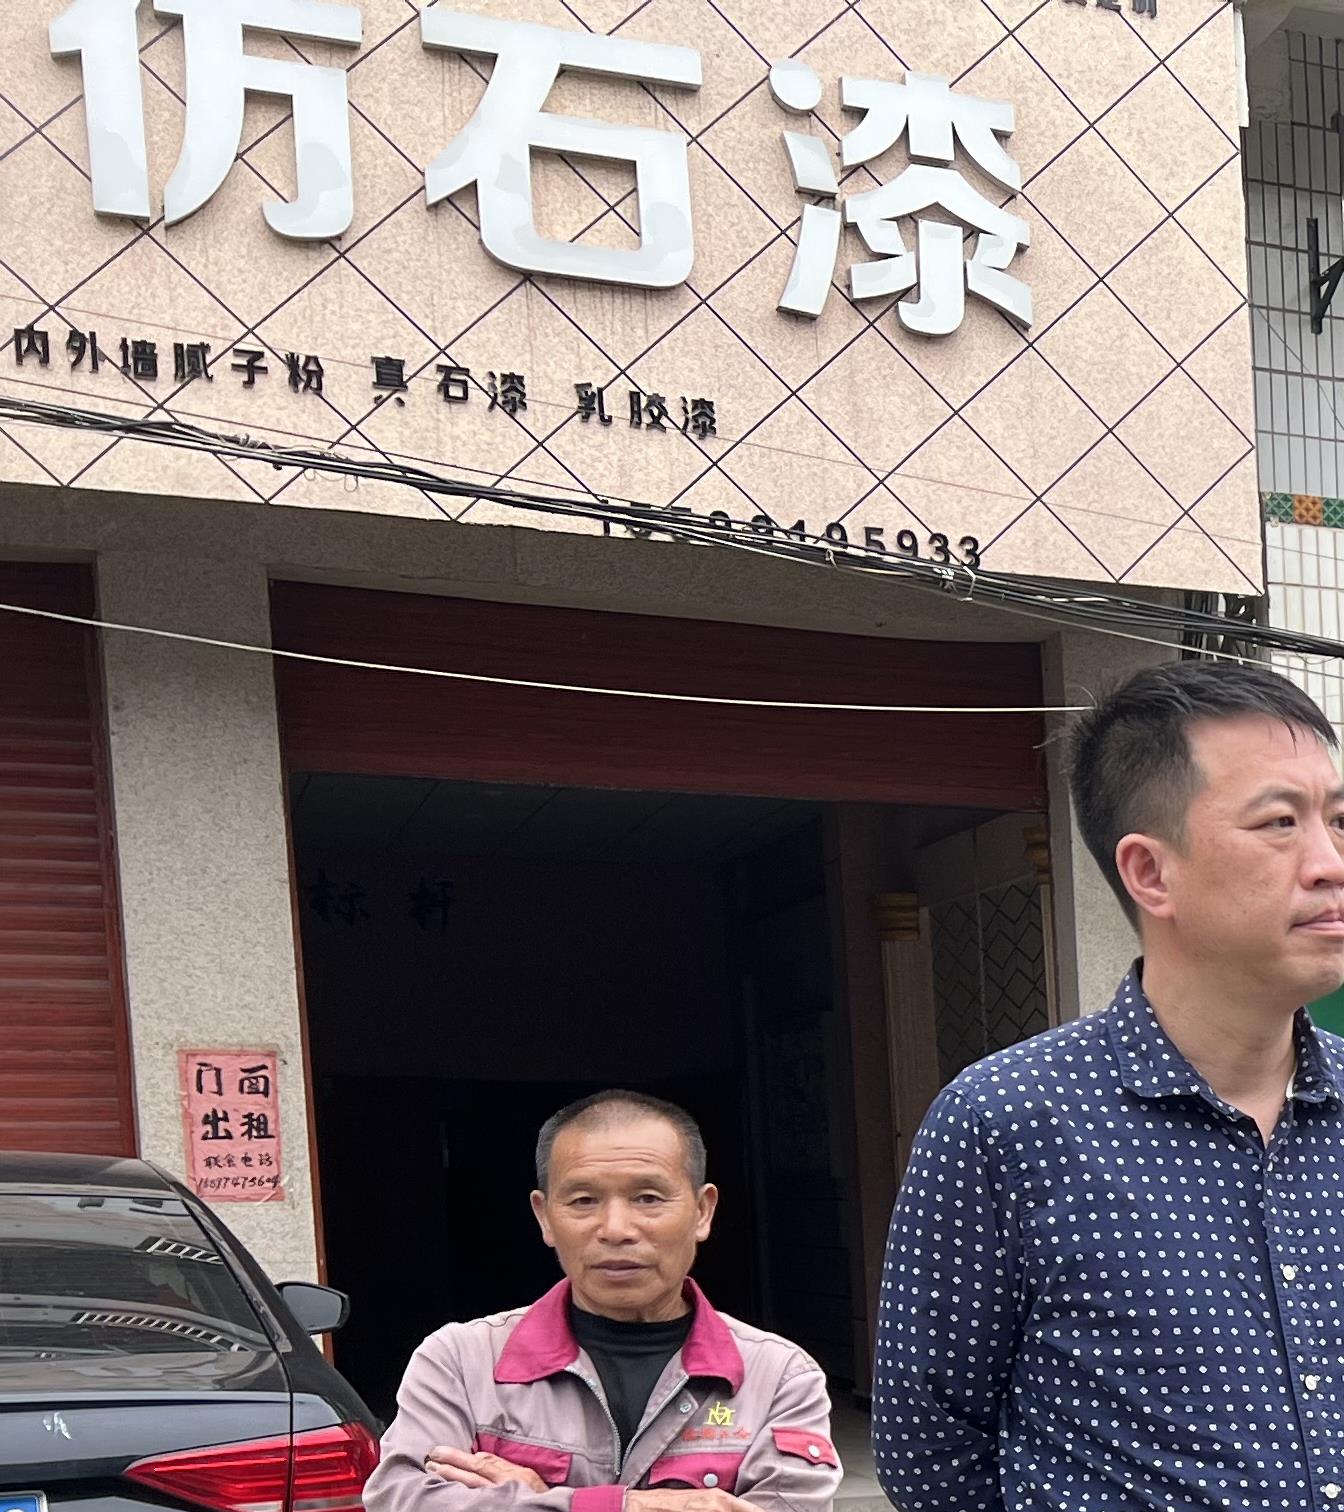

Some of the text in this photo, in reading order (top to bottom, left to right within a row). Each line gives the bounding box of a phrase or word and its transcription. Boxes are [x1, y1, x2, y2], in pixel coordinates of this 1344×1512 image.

[371, 356, 528, 414] 真石漆
[574, 381, 717, 440] 乳胶漆
[195, 1062, 270, 1099] 门面
[200, 1107, 276, 1141] 出租
